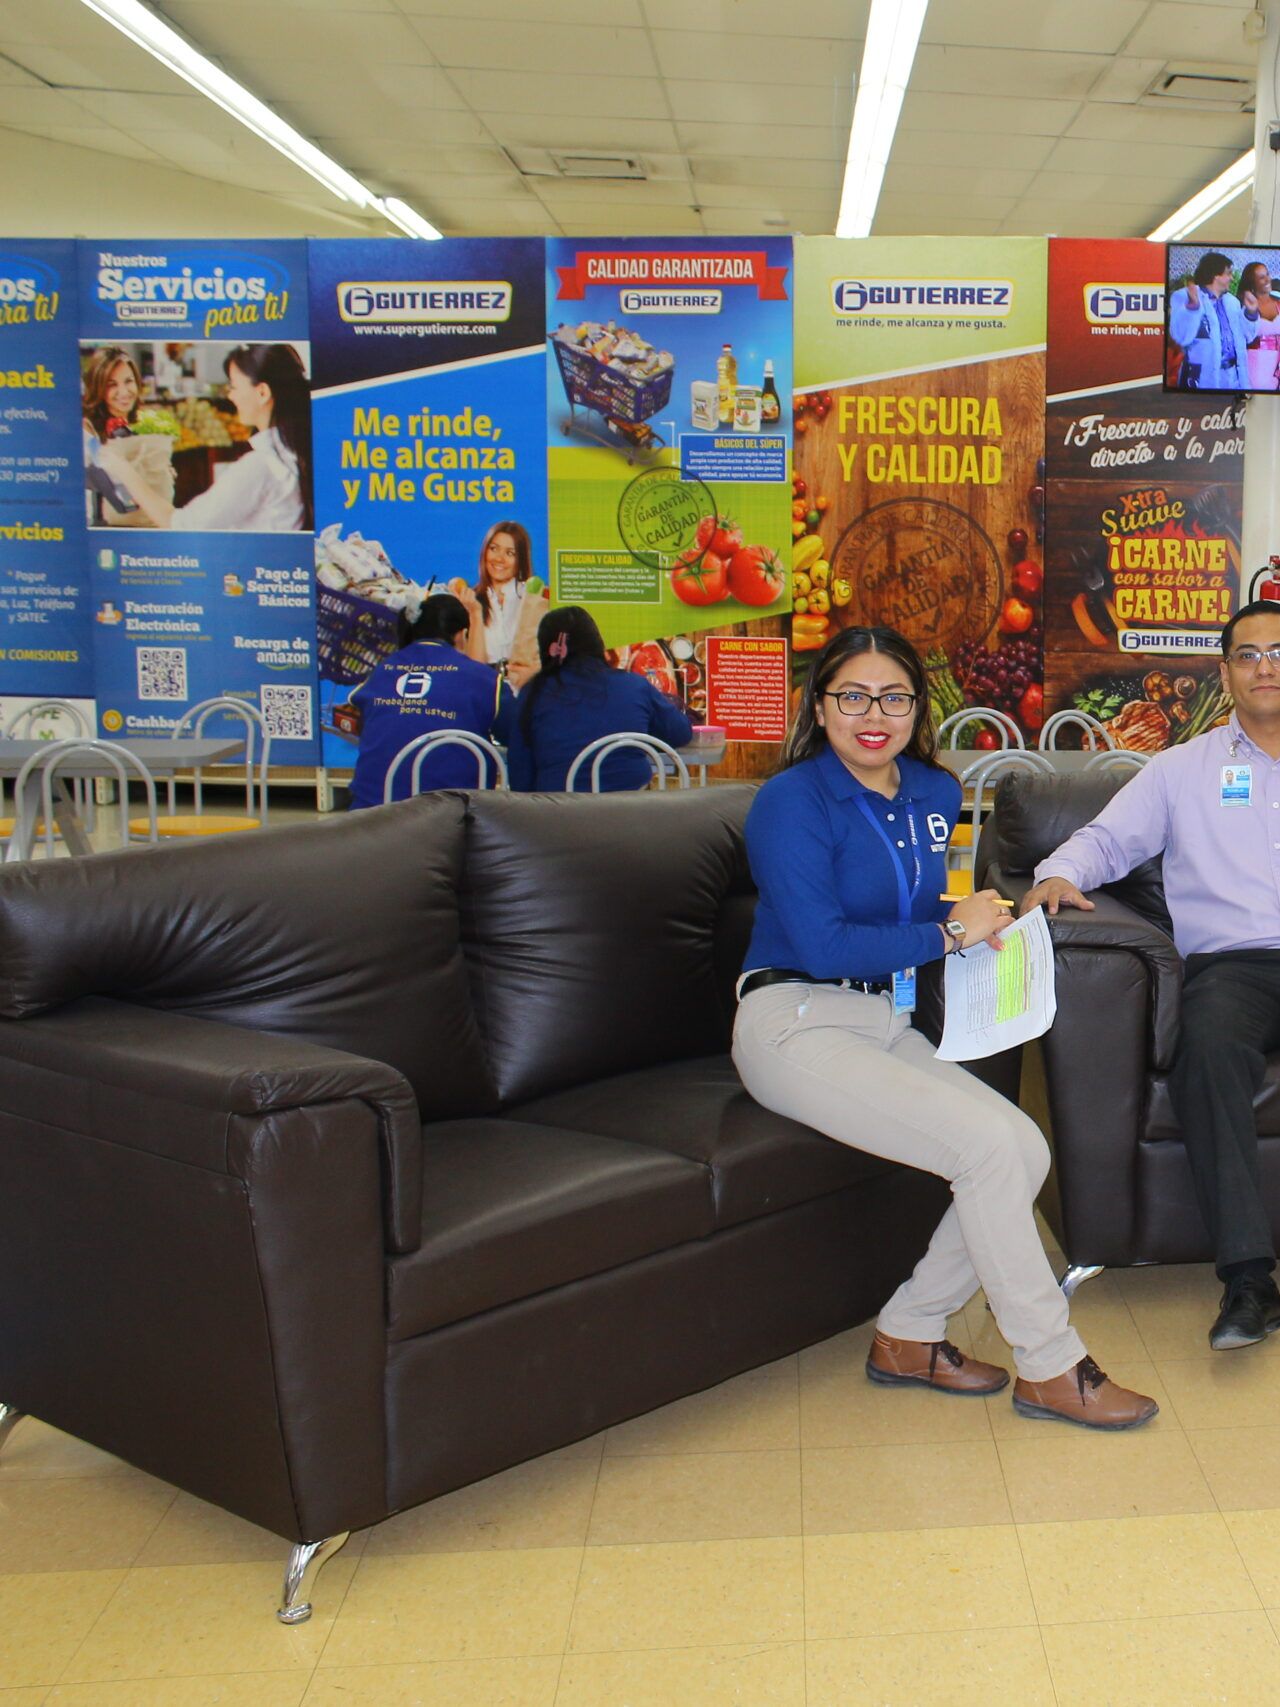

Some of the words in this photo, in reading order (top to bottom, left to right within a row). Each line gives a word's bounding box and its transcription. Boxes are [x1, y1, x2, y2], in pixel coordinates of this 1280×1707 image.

[99, 253, 167, 268] Nuestros
[587, 258, 649, 279] CALIDAD
[652, 258, 753, 279] GARANTIZADA
[97, 268, 266, 301] Servicios
[376, 291, 506, 309] GUTIERREZ
[869, 287, 1009, 305] GUTIERREZ
[1125, 293, 1164, 311] GU
[204, 301, 259, 337] para
[264, 291, 288, 321] ti!
[354, 323, 497, 336] www.supergutierrez.com
[836, 319, 852, 327] me
[854, 317, 885, 328] rinde,
[887, 319, 904, 327] me
[905, 317, 944, 328] alcanza
[947, 320, 953, 330] y
[956, 320, 971, 328] me
[974, 319, 1007, 330] gusta.
[1091, 327, 1108, 335] me
[1110, 325, 1141, 336] rinde,
[1144, 327, 1160, 336] me
[353, 408, 400, 436] Me
[408, 406, 502, 441] rinde,
[838, 396, 1003, 436] FRESCURA
[1177, 418, 1192, 440] y
[341, 440, 388, 469] Me
[395, 440, 515, 469] alcanza
[1090, 440, 1154, 468] directo
[1163, 446, 1177, 461] a
[1186, 436, 1204, 458] la
[837, 443, 859, 482] Y
[867, 444, 1003, 485] CALIDAD
[342, 479, 361, 509] y
[369, 473, 416, 501] Me
[423, 473, 515, 502] Gusta
[638, 492, 690, 522] GARANTIA
[660, 511, 673, 524] DE
[1101, 500, 1186, 537] Suave
[646, 512, 698, 544] CALIDAD
[120, 554, 199, 568] Facturación
[1109, 538, 1227, 571] ¡CARNE
[255, 567, 290, 582] Pago
[292, 567, 310, 580] de
[1114, 571, 1149, 585] con
[1152, 569, 1205, 586] sabor
[1210, 574, 1225, 587] a
[247, 580, 310, 594] Servicios
[124, 601, 204, 615] Facturación
[258, 594, 310, 608] Básicos
[1115, 588, 1232, 622] CARNE!
[126, 618, 201, 632] Electrónica
[233, 635, 290, 651] Recarga
[292, 637, 310, 650] de
[720, 641, 743, 651] CARNE
[759, 642, 783, 652] SABOR
[9, 650, 79, 662] COMISIONES
[256, 651, 310, 664] amazon
[397, 664, 425, 672] mejor
[400, 707, 422, 715] para
